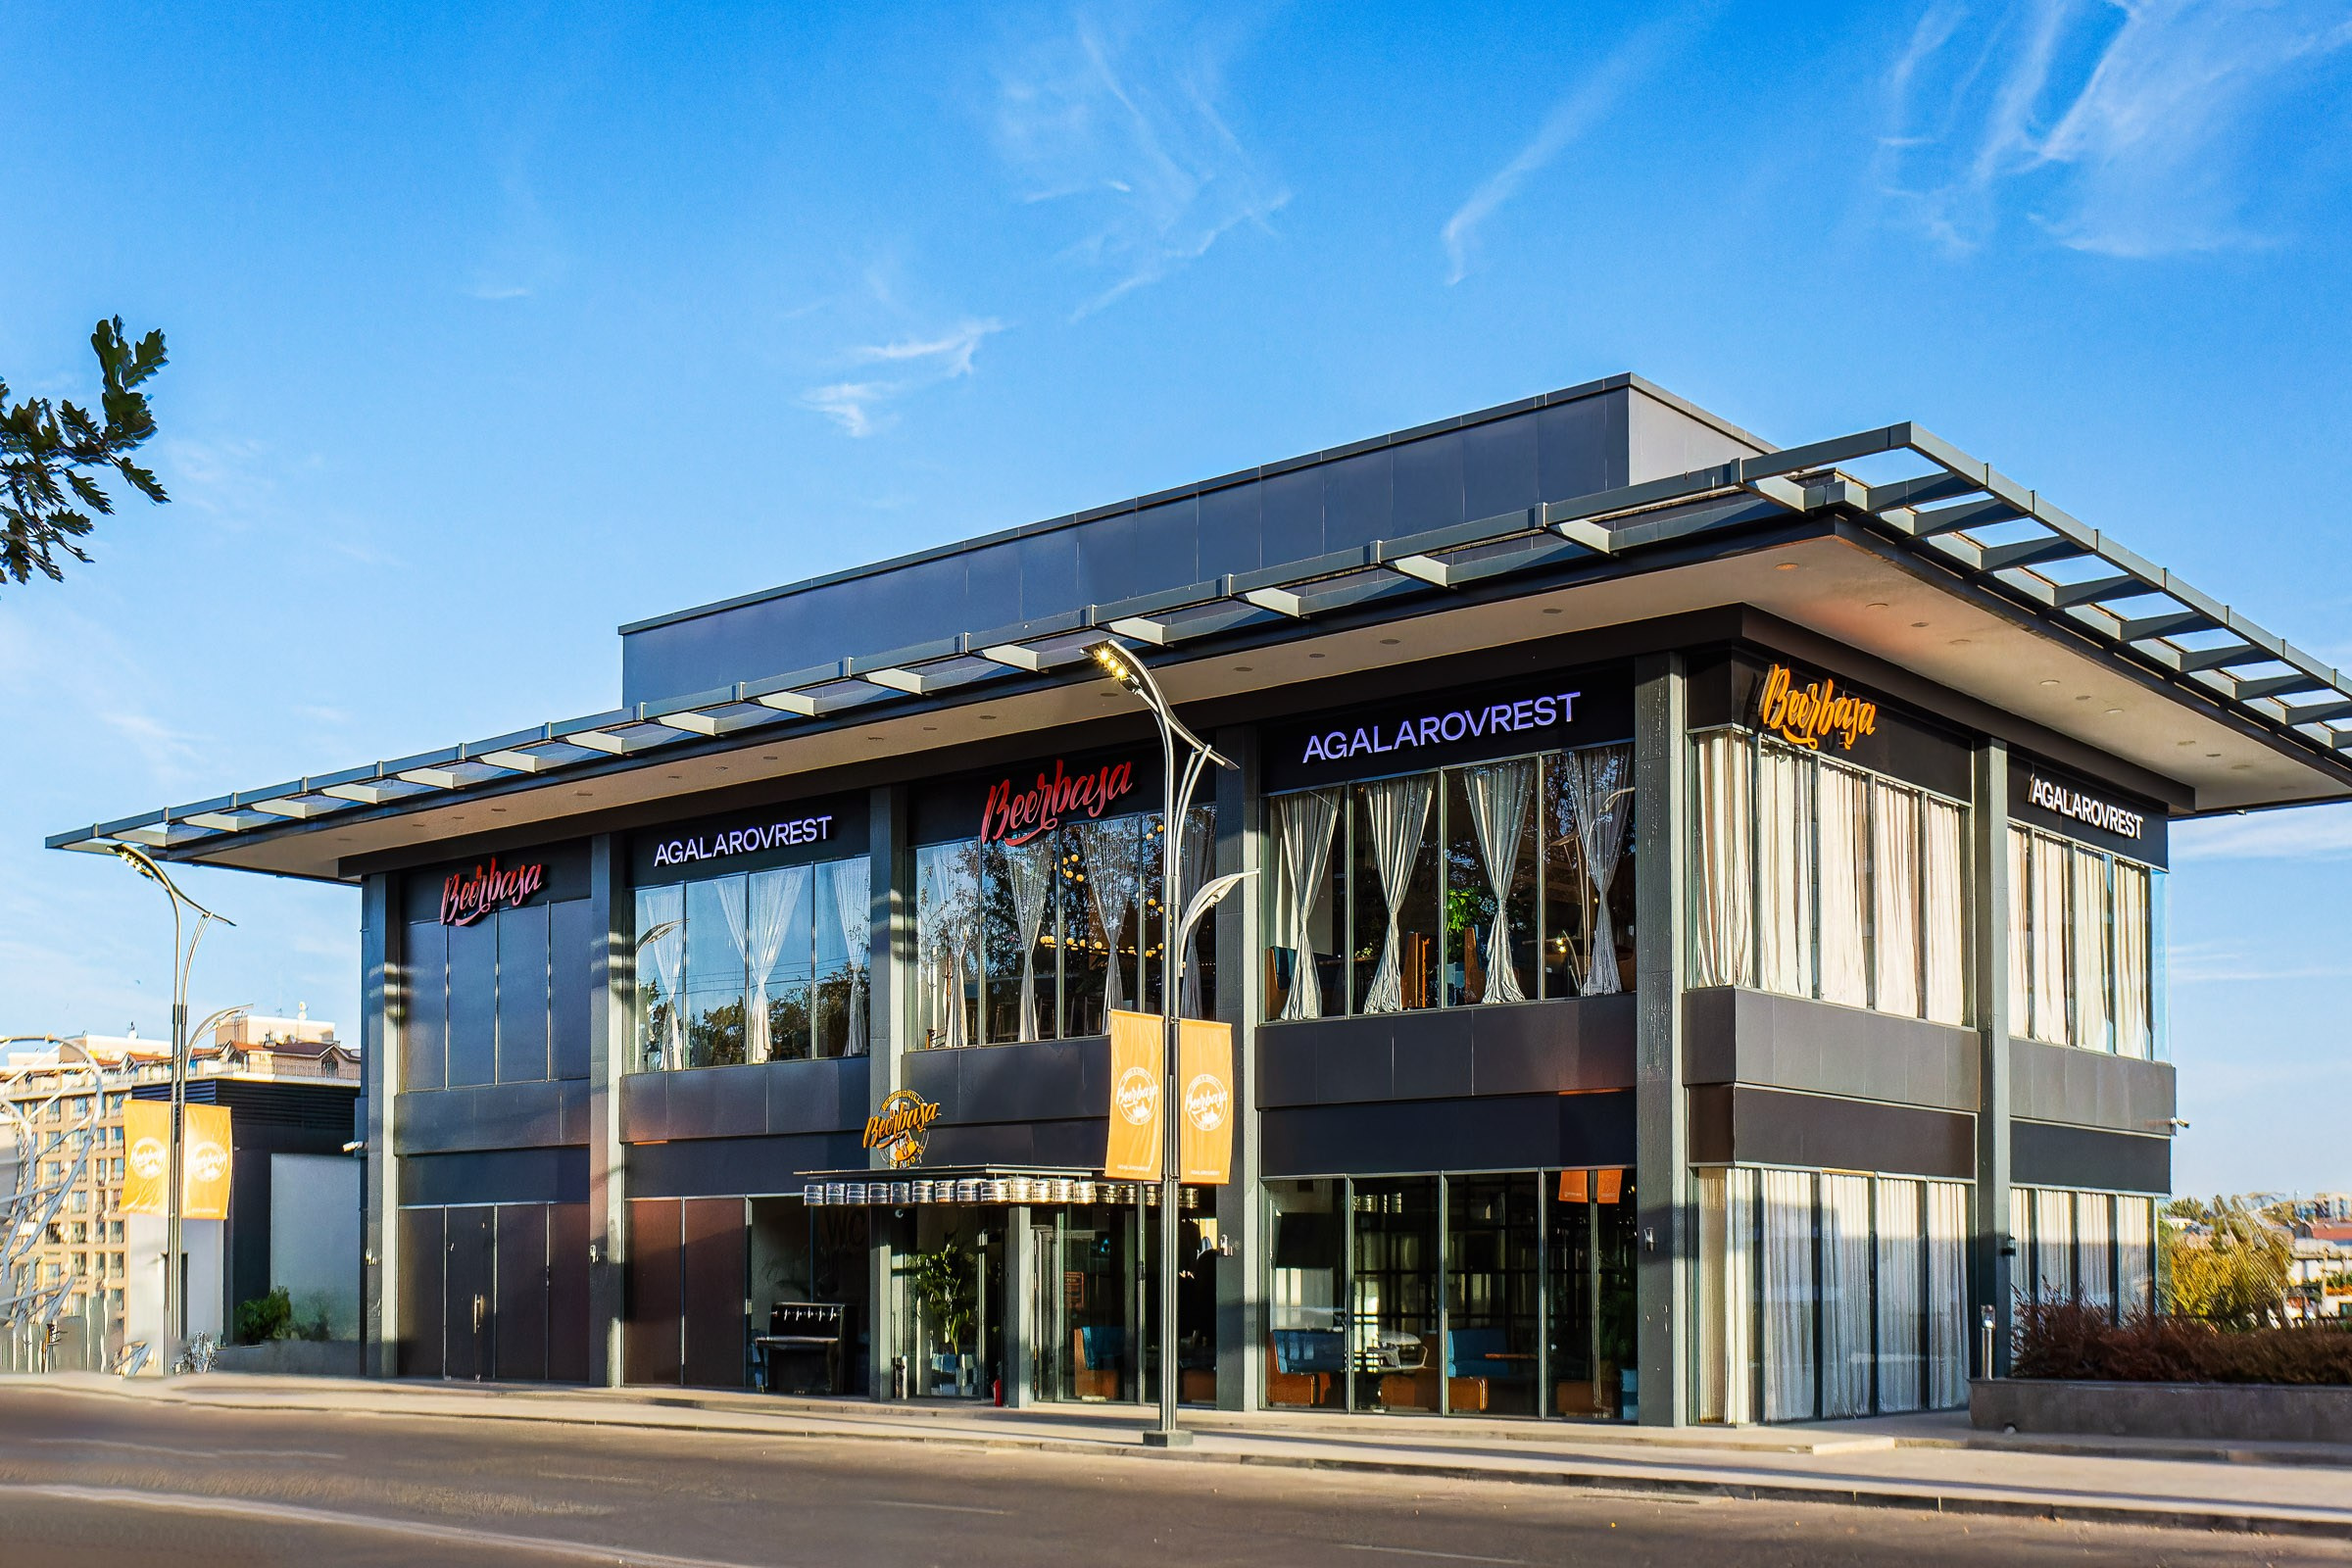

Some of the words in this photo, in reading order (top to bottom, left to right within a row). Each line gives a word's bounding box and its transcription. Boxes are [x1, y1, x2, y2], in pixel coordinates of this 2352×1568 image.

[1301, 691, 1581, 764] AGALAROVREST
[980, 759, 1133, 847] Beerbasa
[2032, 778, 2143, 840] AGALAROVREST
[654, 815, 833, 867] AGALAROVREST
